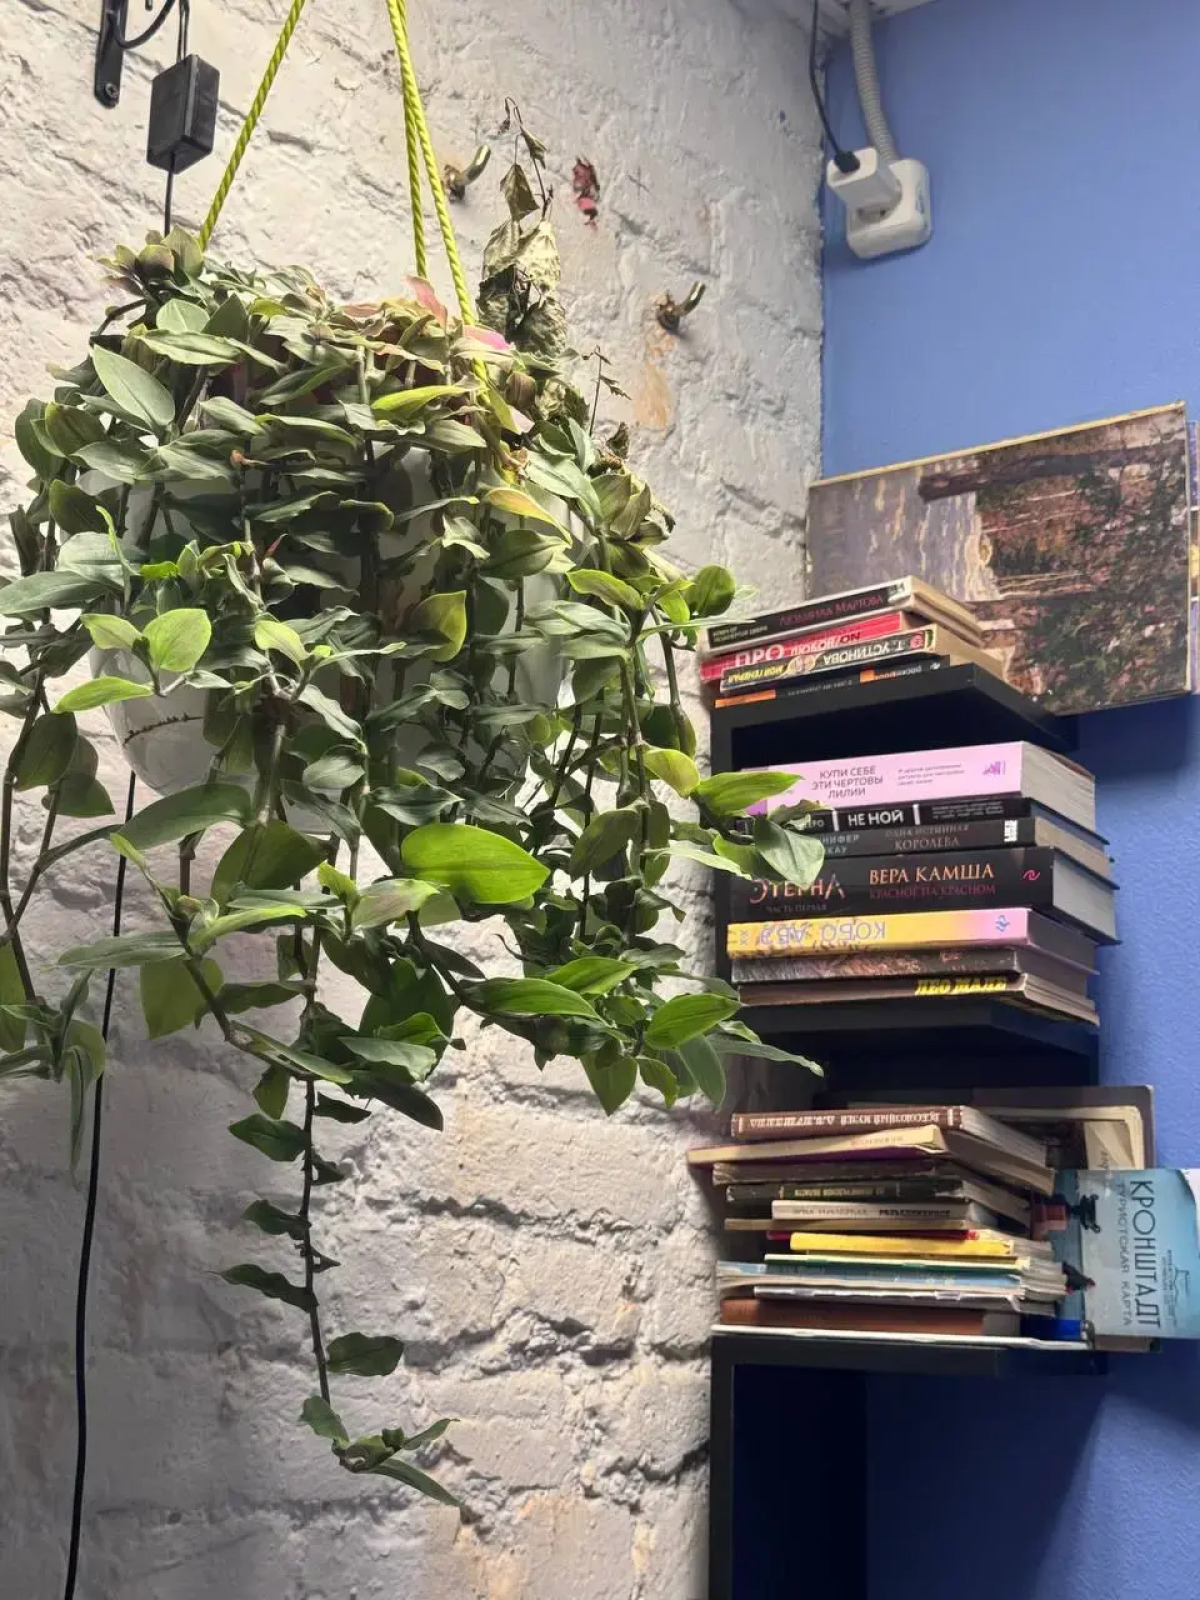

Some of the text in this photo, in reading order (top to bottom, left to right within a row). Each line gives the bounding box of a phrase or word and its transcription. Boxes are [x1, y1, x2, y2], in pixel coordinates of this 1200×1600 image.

[734, 644, 784, 668] ПРО
[823, 641, 890, 665] УСТИНОВА
[812, 776, 883, 791] ЭТИ ЧЕРТОВЫ
[819, 765, 876, 780] КУПИ СЕБЕ
[828, 787, 866, 799] ЛИЛИИ
[847, 808, 905, 827] НЕ НОЙ
[894, 837, 960, 851] КОРОЛЕВА
[869, 864, 995, 886] ВЕРА КАМША
[759, 920, 886, 944] КОБО АБЭ
[1116, 1183, 1133, 1327] ТУРИСТСКАЯ КАРТА
[1130, 1180, 1161, 1328] КРОНШТАДТ
